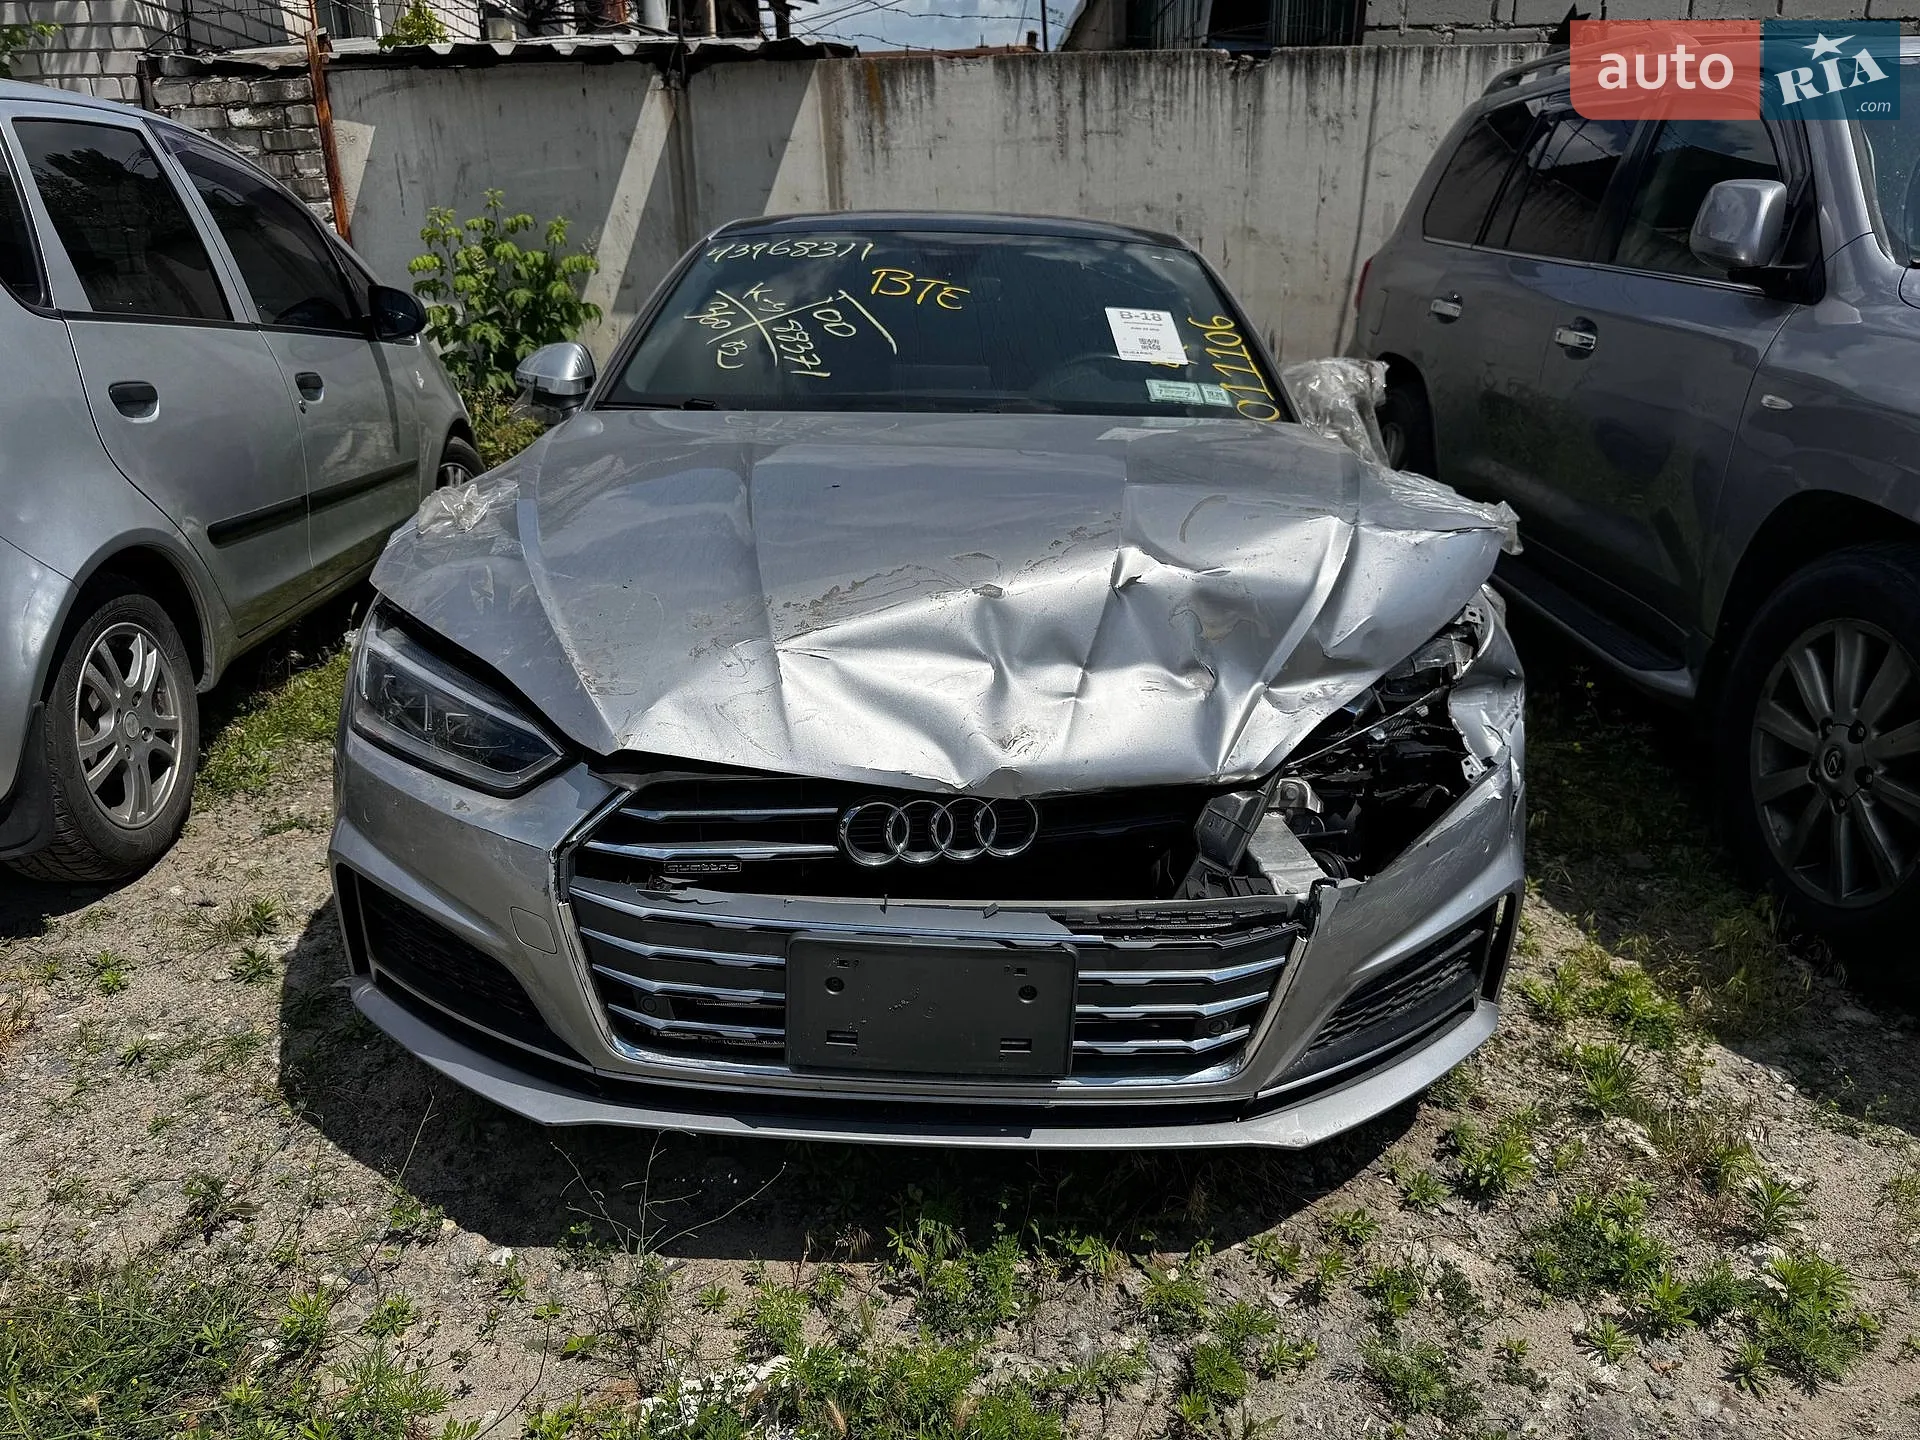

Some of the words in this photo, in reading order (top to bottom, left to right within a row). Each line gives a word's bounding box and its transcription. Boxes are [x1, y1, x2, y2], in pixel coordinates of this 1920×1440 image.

[706, 239, 874, 263] 43968311
[871, 268, 970, 310] BTE
[1119, 310, 1162, 322] B-18
[667, 863, 739, 873] quattro
